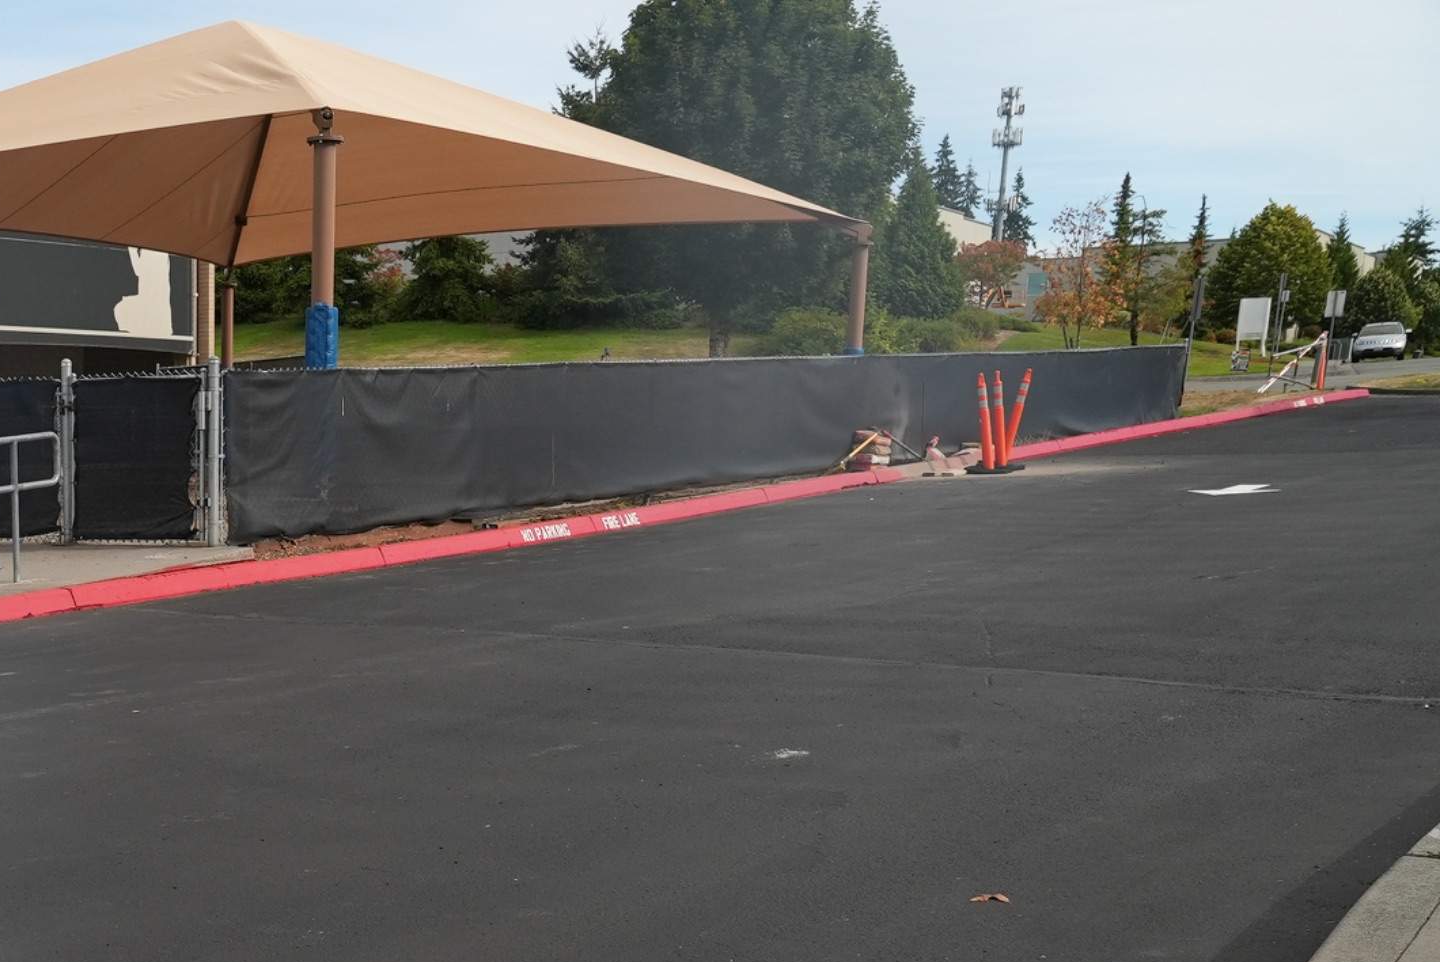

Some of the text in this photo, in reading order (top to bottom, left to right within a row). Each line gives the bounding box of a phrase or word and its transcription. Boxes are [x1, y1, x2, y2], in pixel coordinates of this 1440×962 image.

[520, 512, 640, 542] NO PARKING FIRE LANE
